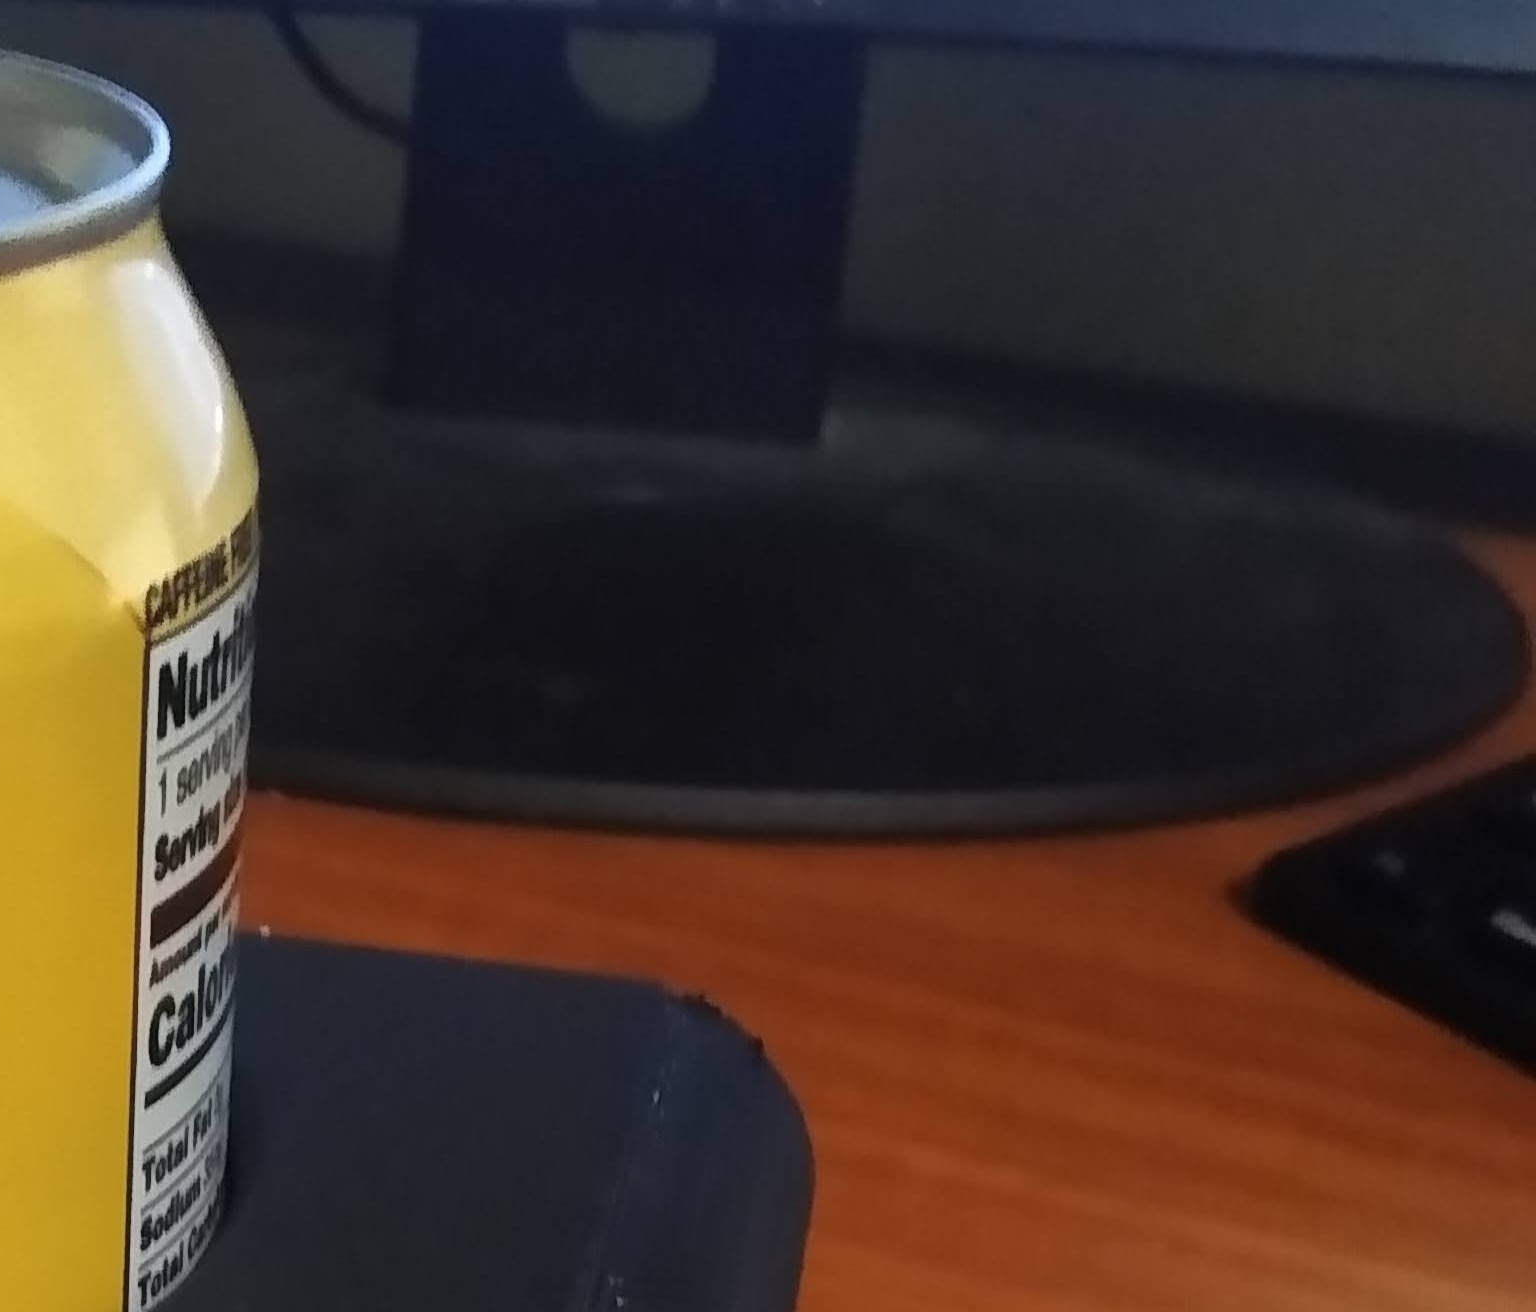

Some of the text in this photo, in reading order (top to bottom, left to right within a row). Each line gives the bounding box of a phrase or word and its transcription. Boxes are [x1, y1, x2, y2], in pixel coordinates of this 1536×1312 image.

[158, 765, 168, 819] 1
[154, 799, 221, 883] Serving
[141, 1124, 190, 1193] Total
[139, 1173, 201, 1252] Sodium
[137, 1241, 185, 1308] Total
